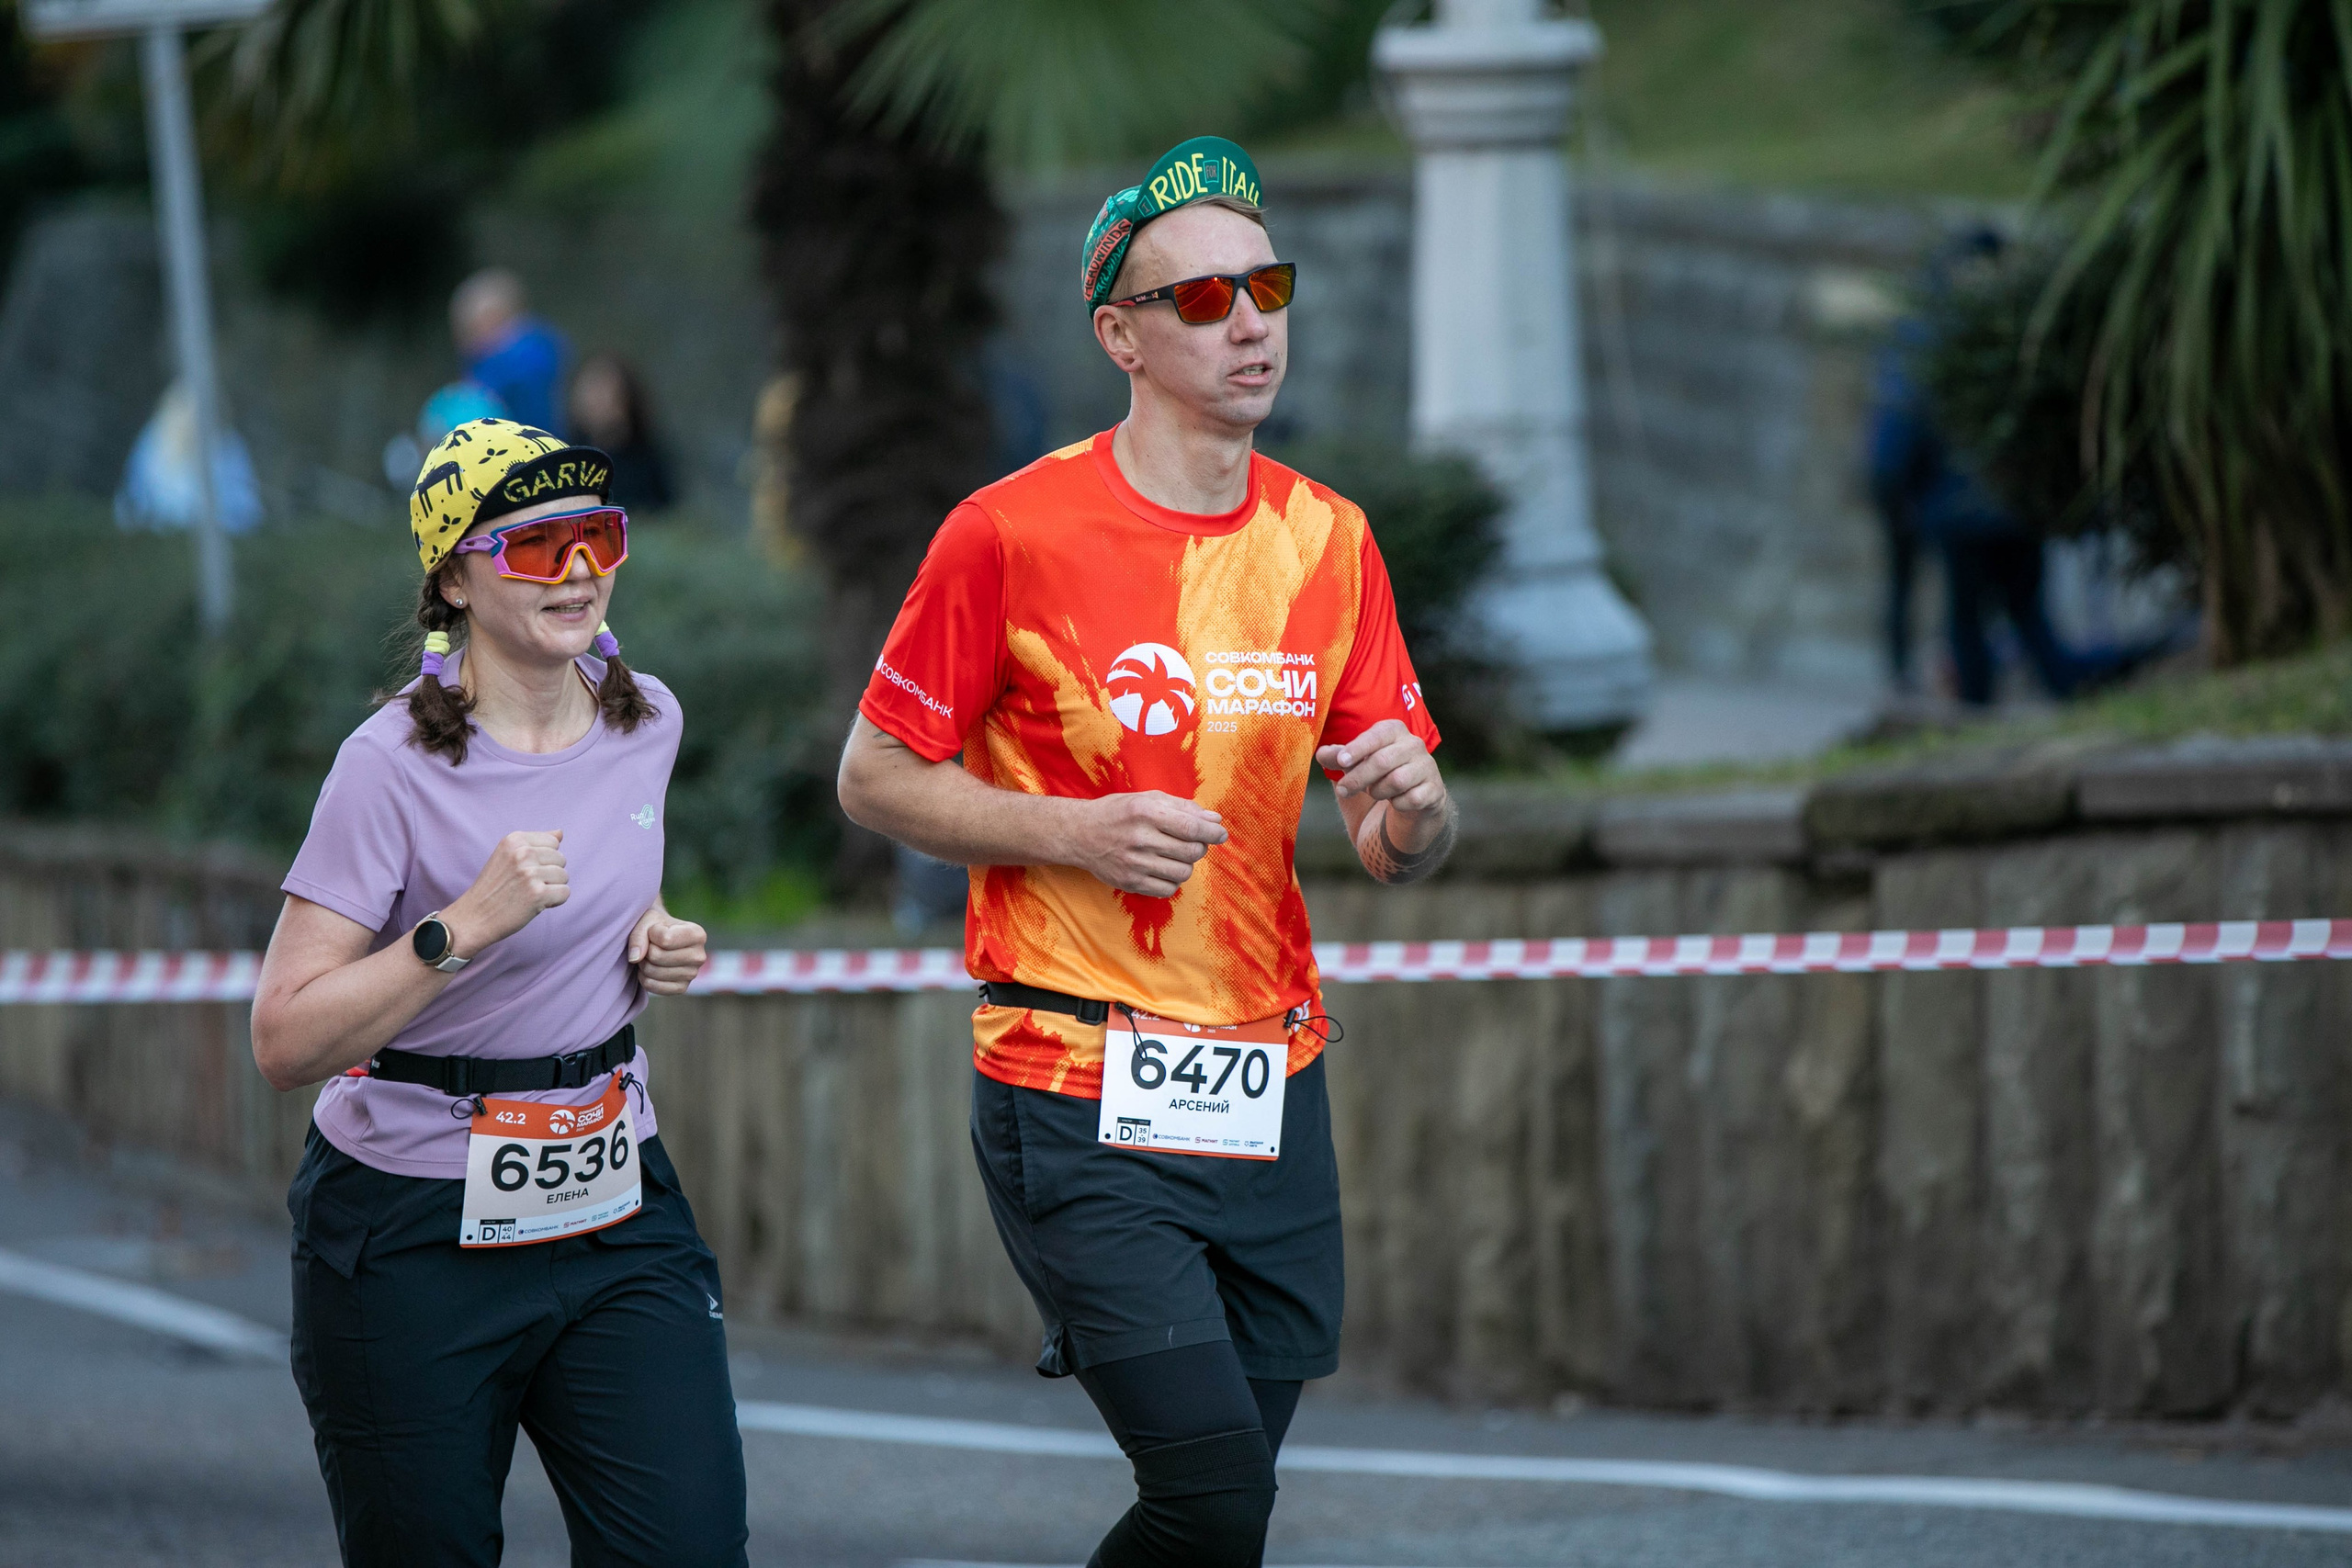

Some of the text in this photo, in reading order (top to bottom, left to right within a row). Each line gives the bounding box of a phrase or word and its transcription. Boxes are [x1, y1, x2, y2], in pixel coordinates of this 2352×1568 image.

[1148, 153, 1207, 210] RIDE
[1205, 164, 1217, 179] FOR
[1085, 220, 1131, 297] HEADWINDS
[504, 461, 608, 502] GARVA
[1205, 651, 1316, 666] СОВКОМБАНК
[880, 662, 954, 718] СОВКОМБАНК
[1205, 668, 1317, 699] СОЧИ
[1206, 698, 1316, 717] МАРАФОН
[1206, 720, 1238, 732] 2025
[1131, 1039, 1270, 1099] 6470
[577, 1106, 604, 1122] СОЧИ
[1169, 1099, 1230, 1114] АРСЕНИЙ
[495, 1111, 526, 1125] 42.2
[1119, 1125, 1132, 1141] D
[491, 1119, 628, 1192] 6536
[546, 1188, 589, 1204] ЕЛЕНА
[481, 1226, 496, 1241] D
